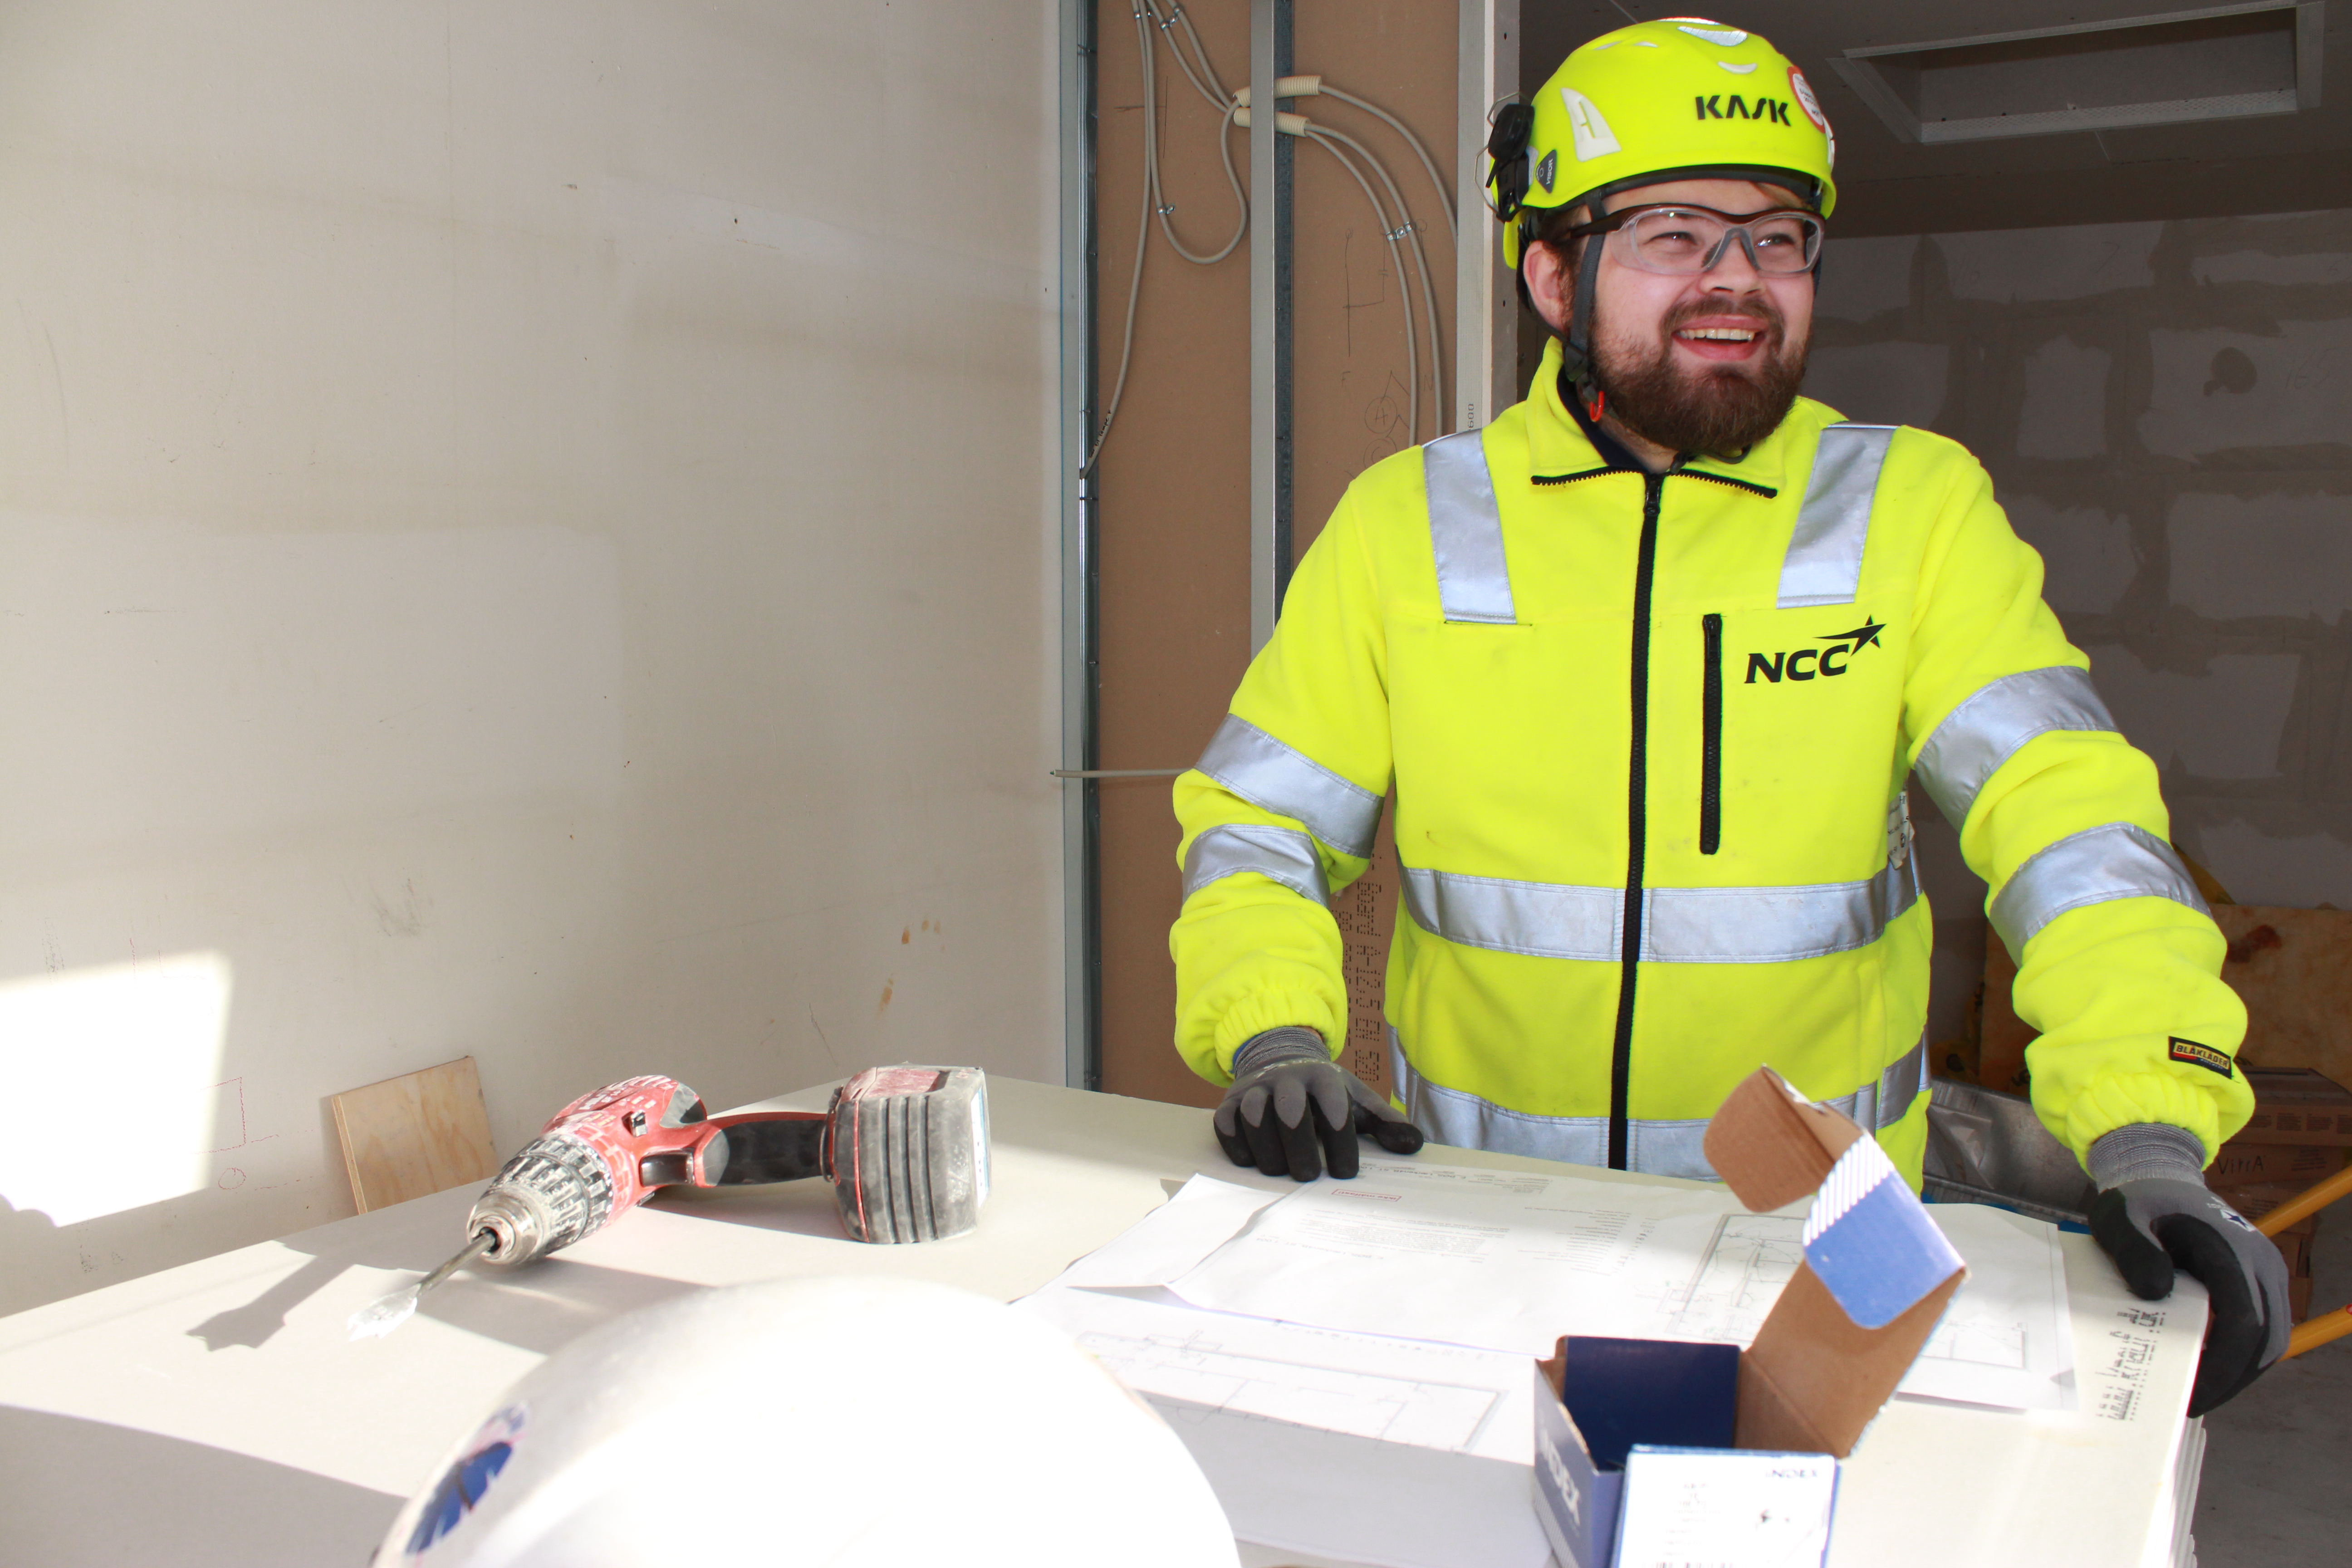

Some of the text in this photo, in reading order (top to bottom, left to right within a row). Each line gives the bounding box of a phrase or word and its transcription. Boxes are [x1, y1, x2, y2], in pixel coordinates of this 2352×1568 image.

[1695, 95, 1792, 127] KASK
[1744, 643, 1850, 684] NCC
[1357, 882, 1382, 937] Board
[1356, 1018, 1380, 1042] EN
[1355, 1050, 1380, 1082] 520
